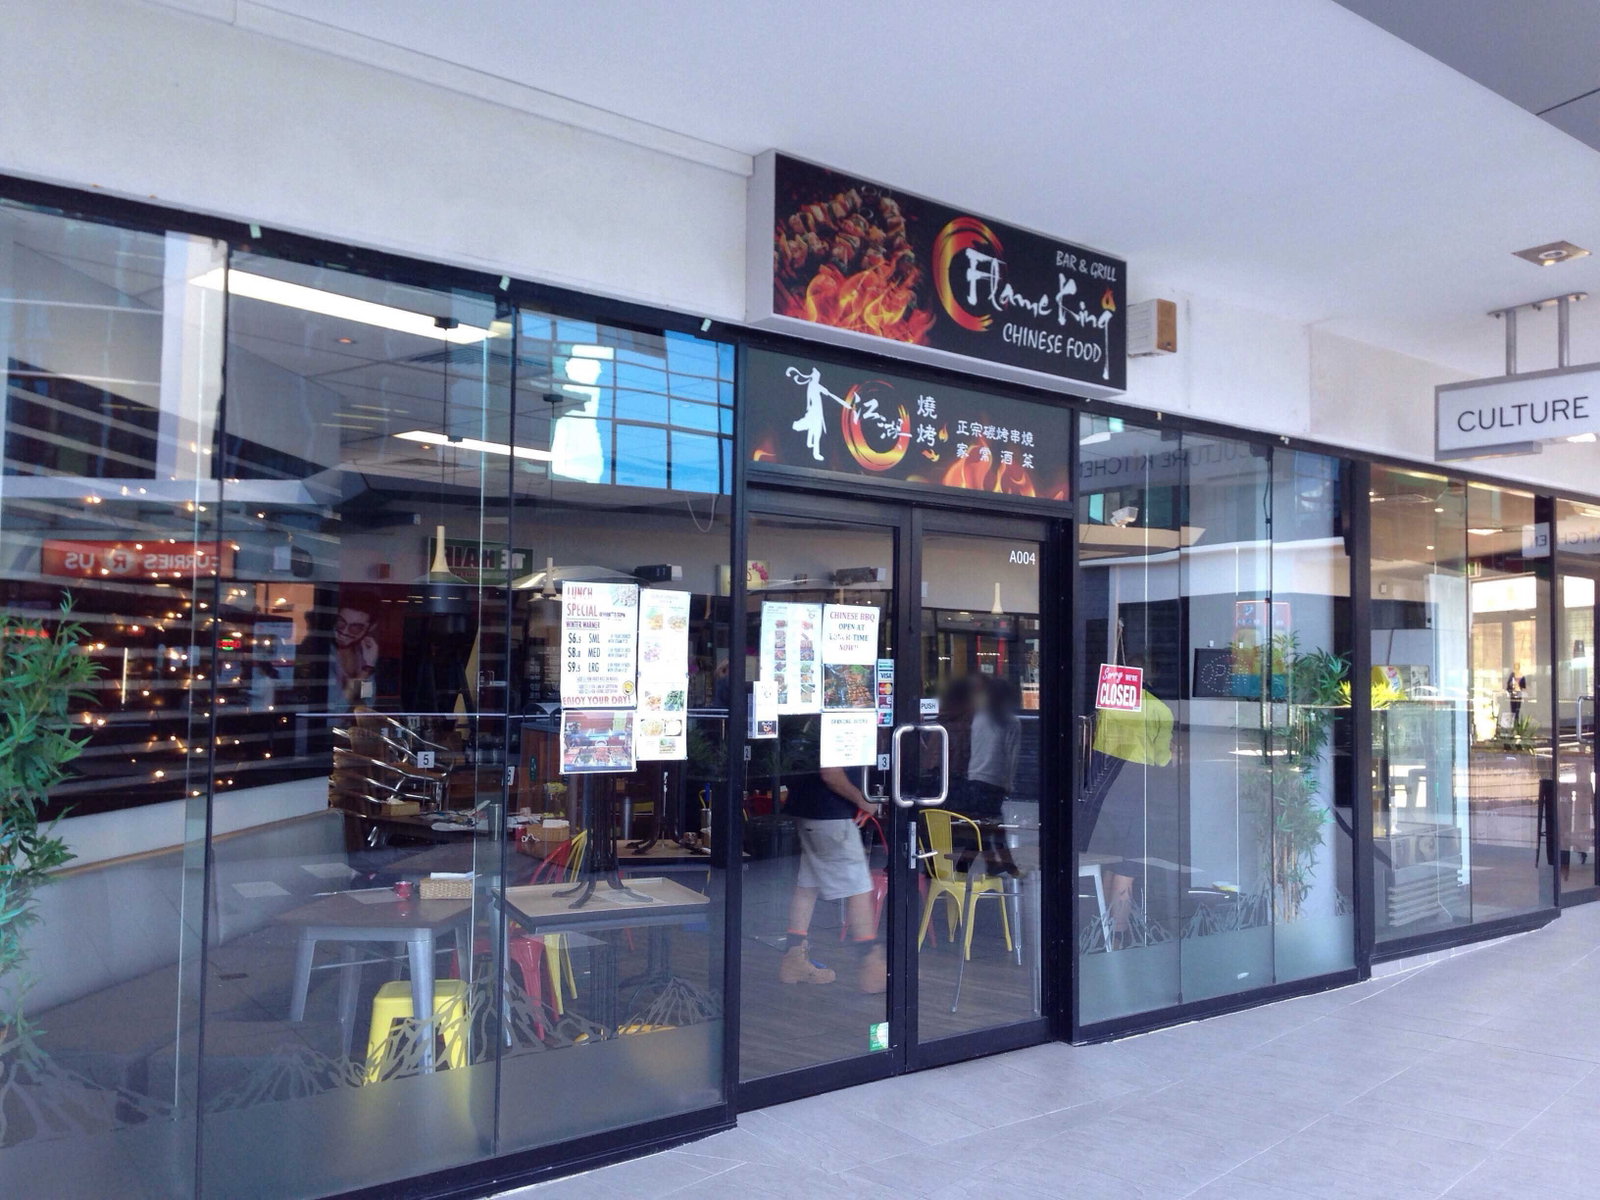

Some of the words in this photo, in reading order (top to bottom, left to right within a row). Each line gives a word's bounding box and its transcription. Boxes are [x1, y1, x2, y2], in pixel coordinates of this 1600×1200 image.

[1056, 251, 1077, 271] BAR
[1079, 260, 1088, 273] &
[1090, 262, 1117, 282] GRILL
[965, 248, 1052, 316] Flame
[1056, 273, 1116, 381] King
[1002, 323, 1062, 353] CHINESE
[1066, 339, 1102, 363] FOOD
[853, 392, 913, 449] 江湖
[916, 394, 938, 448] 燒烤
[1457, 396, 1590, 432] CULTURE
[956, 442, 1035, 469] 家常酒菜
[1009, 550, 1036, 565] A004
[567, 586, 593, 599] LUNCH
[567, 603, 598, 617] SPECIAL
[829, 611, 859, 621] CHINESE
[860, 612, 875, 623] BBQ
[838, 622, 856, 631] OPEN
[856, 623, 865, 631] AT
[588, 632, 601, 644] SML
[587, 647, 601, 658] MED
[588, 662, 600, 673] LRG
[1102, 667, 1124, 684] Sorry
[562, 696, 585, 705] ENJOY
[587, 696, 609, 705] YOUR
[1100, 683, 1137, 708] CLOSED
[920, 702, 936, 710] PUSH
[423, 754, 429, 765] 5
[882, 756, 887, 768] 3
